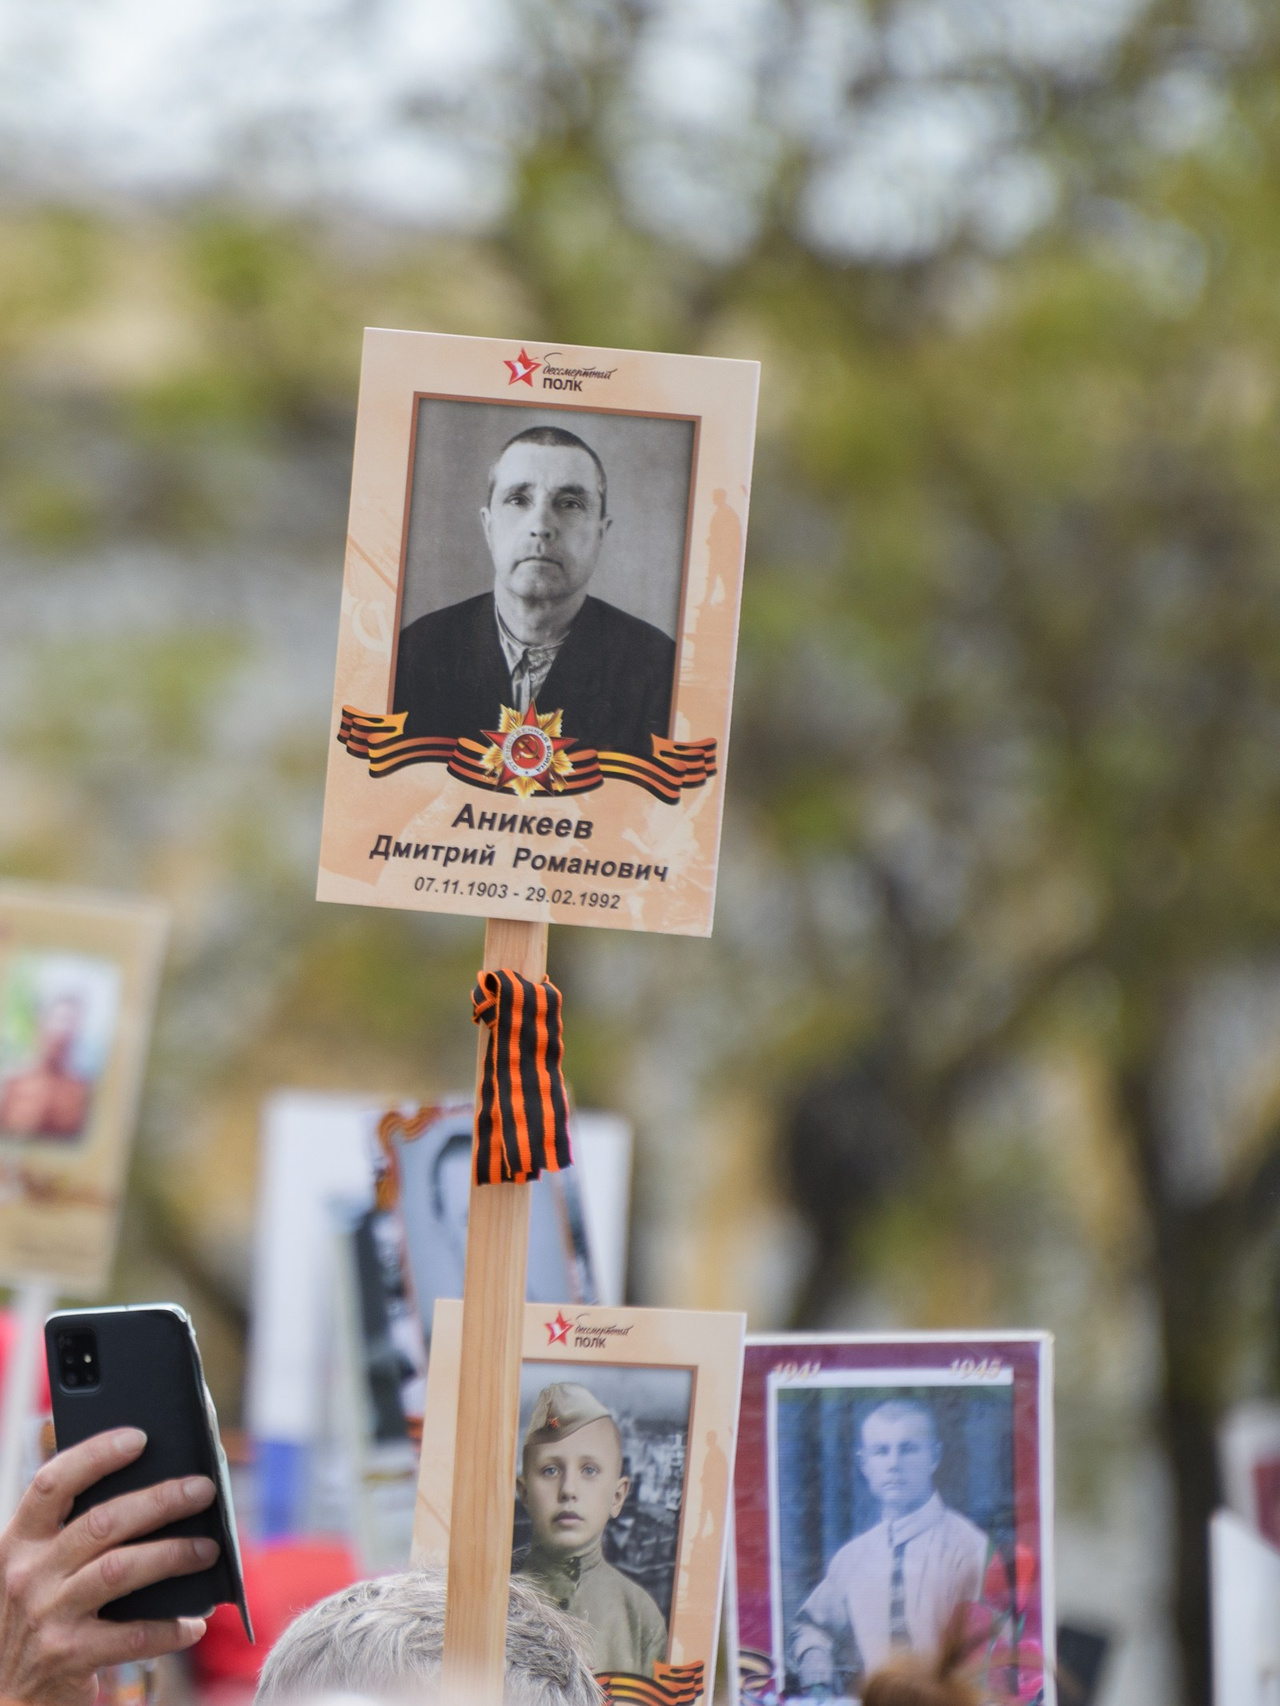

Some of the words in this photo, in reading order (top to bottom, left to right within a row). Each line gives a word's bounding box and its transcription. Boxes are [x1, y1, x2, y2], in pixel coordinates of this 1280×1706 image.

[542, 377, 583, 392] ПОЛК
[451, 803, 594, 840] Аникеев
[369, 834, 496, 867] Дмитрий
[512, 847, 669, 882] Романович
[414, 876, 508, 899] 07.11.1903
[525, 886, 621, 910] 29.02.1992
[575, 1336, 606, 1349] ПОЛК
